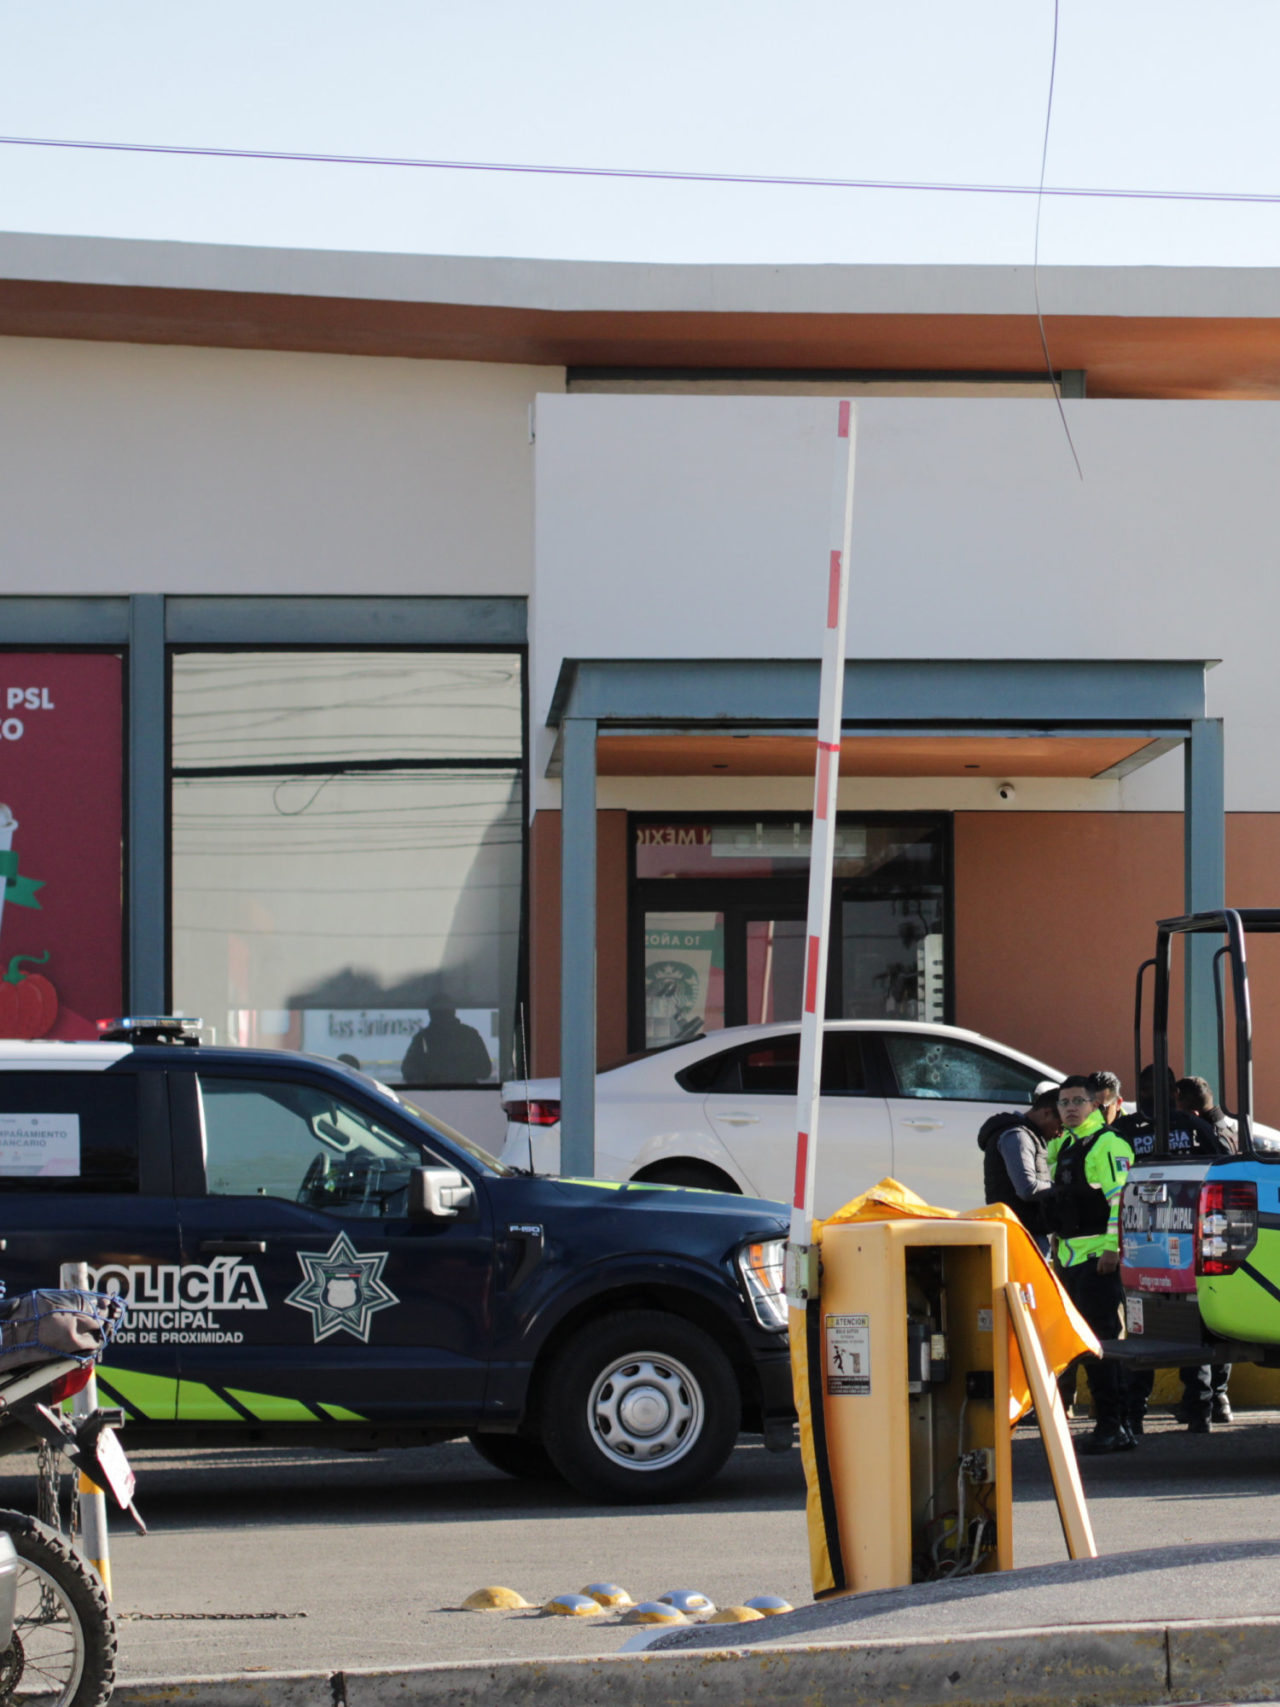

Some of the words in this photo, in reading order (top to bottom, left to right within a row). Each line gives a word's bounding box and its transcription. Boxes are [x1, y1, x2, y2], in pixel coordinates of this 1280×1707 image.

[7, 687, 55, 710] PSL
[0, 718, 24, 741] O
[0, 1139, 47, 1148] ANCARIO
[1156, 1207, 1194, 1230] MUNICIPAL
[60, 1256, 268, 1310] OLICÍA
[139, 1332, 158, 1343] DE
[161, 1332, 243, 1343] PROXIMIDAD
